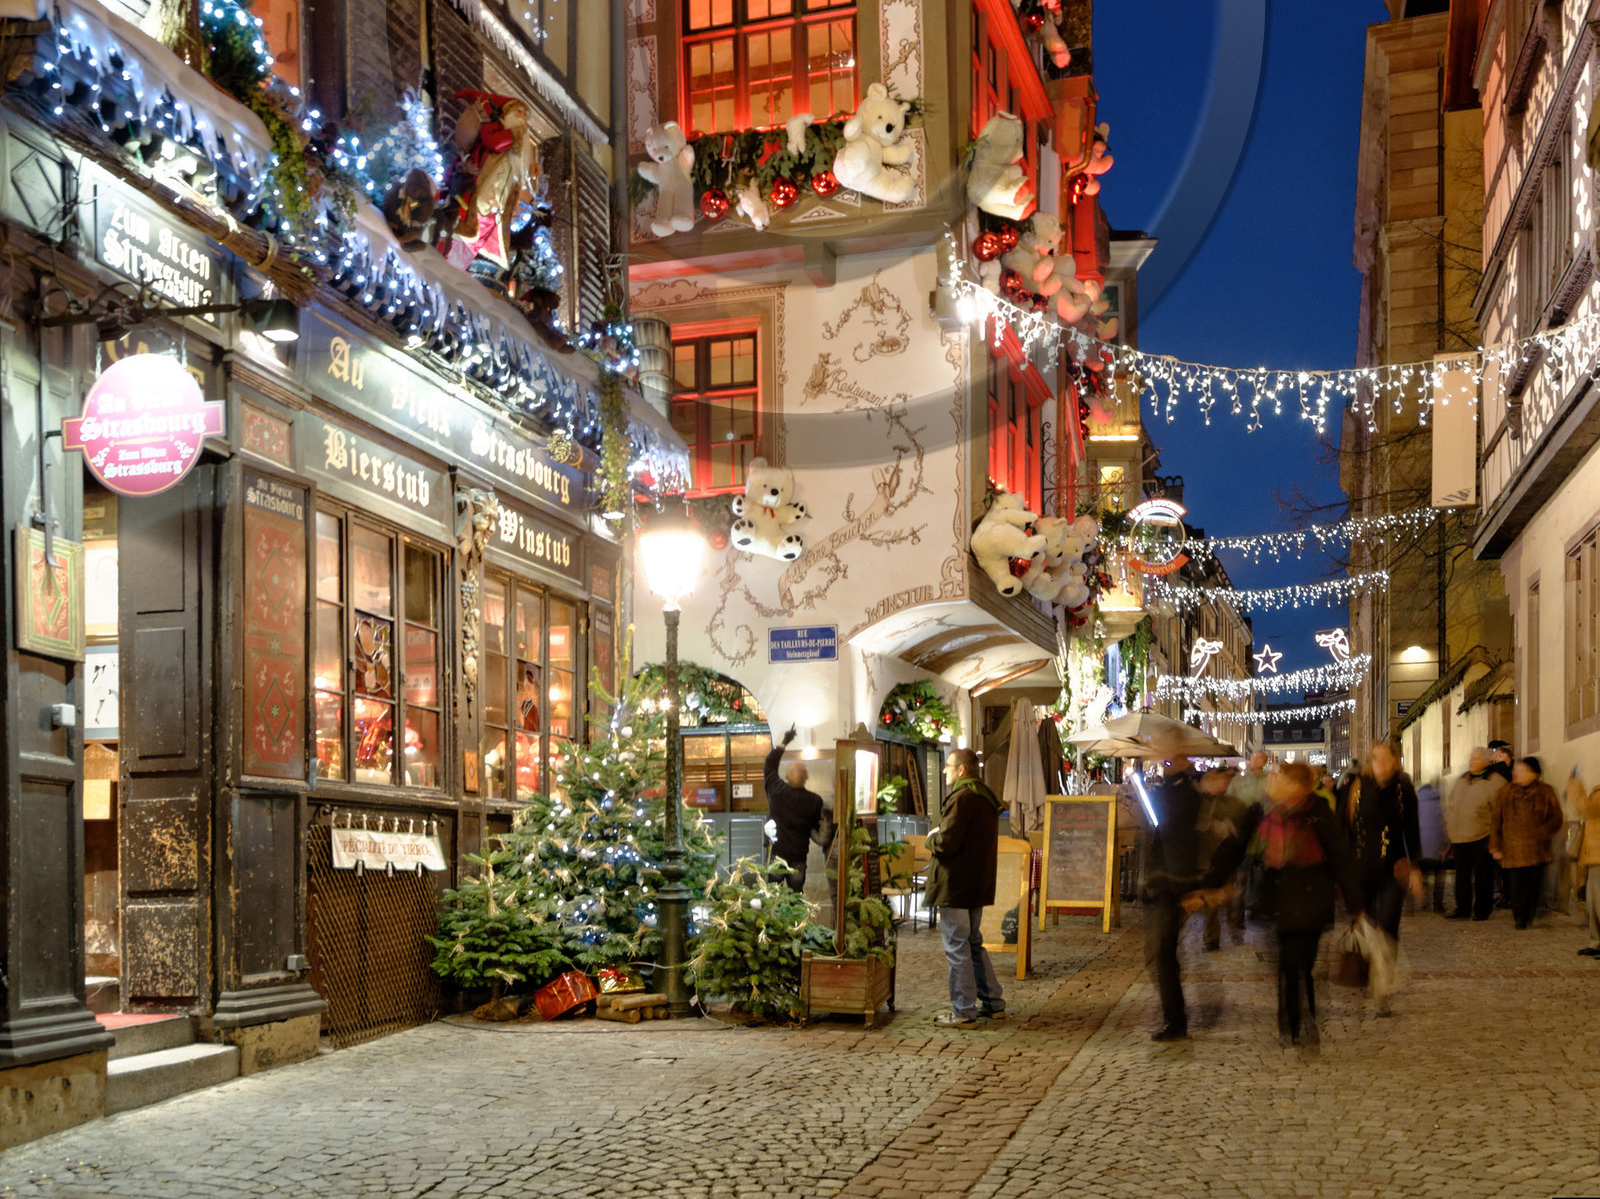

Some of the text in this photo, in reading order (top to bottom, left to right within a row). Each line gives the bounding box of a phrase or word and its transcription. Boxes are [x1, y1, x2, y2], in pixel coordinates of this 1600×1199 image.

[827, 369, 887, 407] Restaurant
[80, 411, 207, 442] Strasbourg
[328, 336, 364, 390] Au
[470, 418, 570, 505] Strasbourg
[323, 424, 430, 507] Bierstub
[498, 505, 570, 568] Winstub
[829, 511, 878, 550] Bouchon
[865, 585, 934, 624] WINSTUB
[797, 630, 808, 638] RUE
